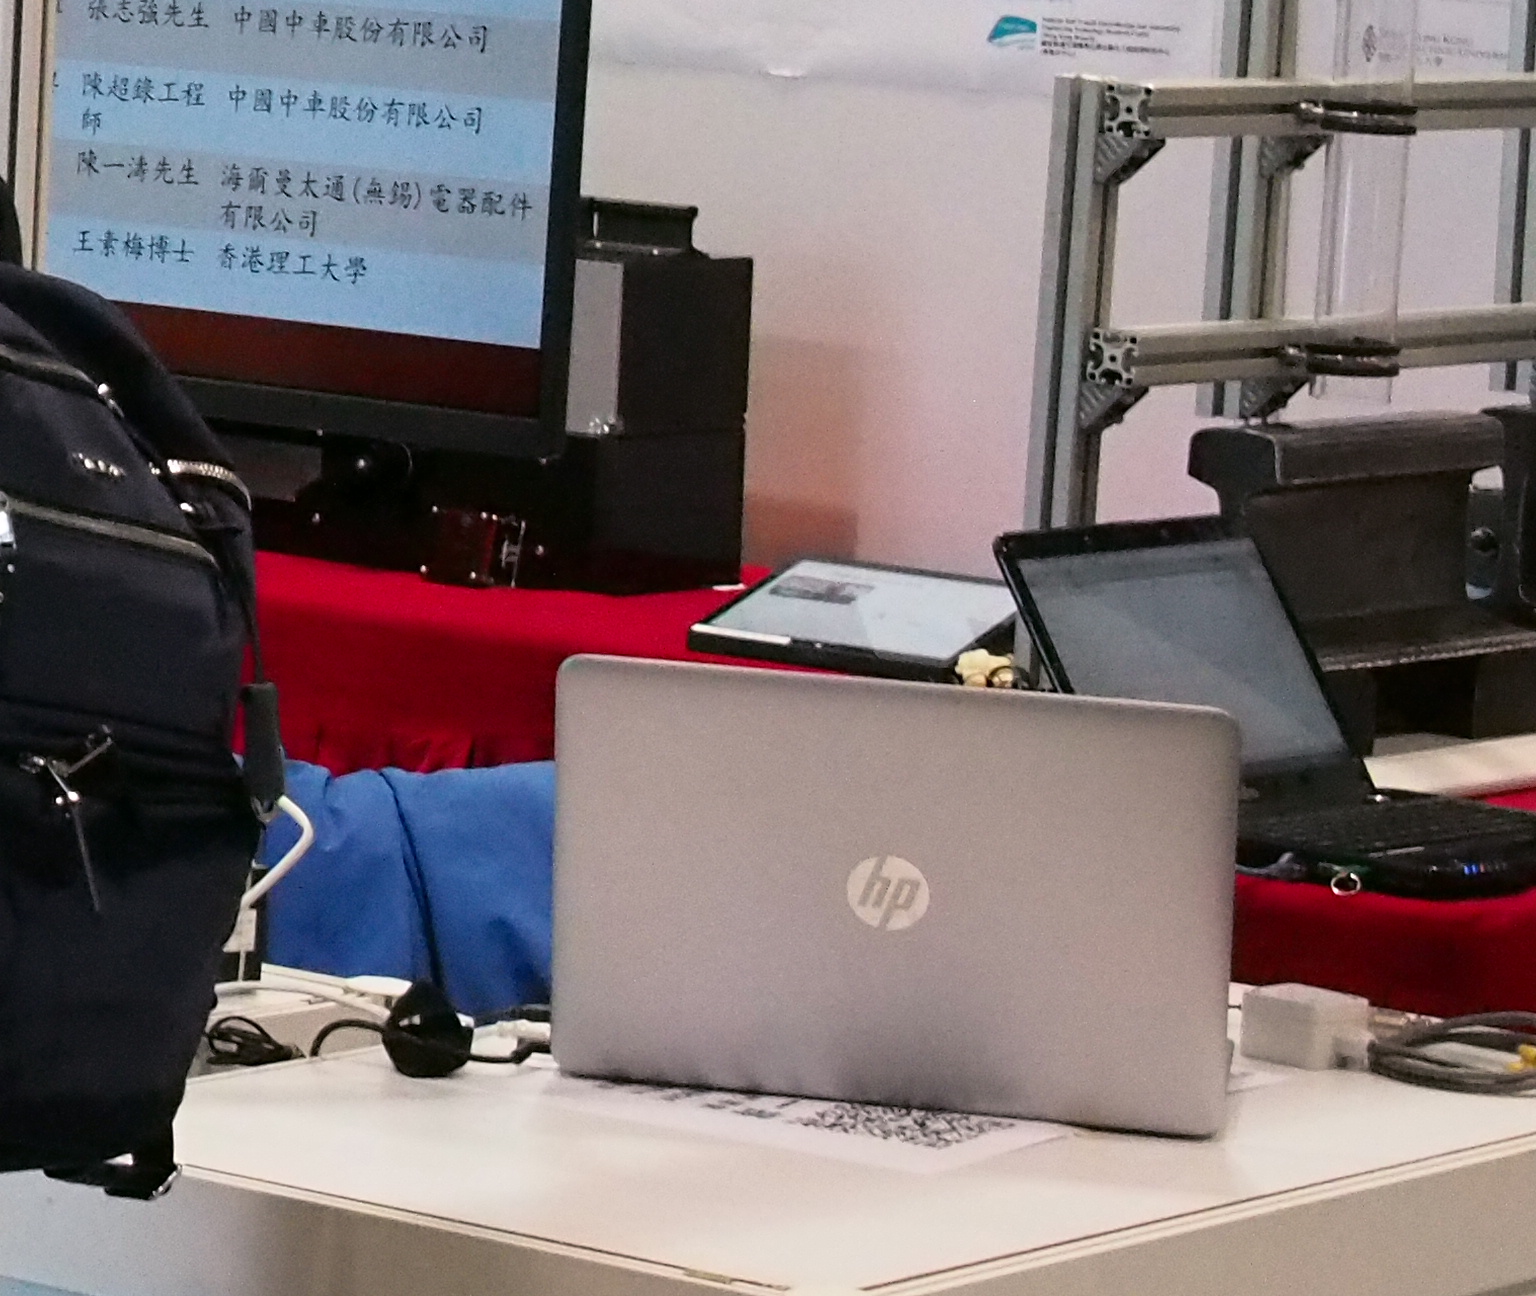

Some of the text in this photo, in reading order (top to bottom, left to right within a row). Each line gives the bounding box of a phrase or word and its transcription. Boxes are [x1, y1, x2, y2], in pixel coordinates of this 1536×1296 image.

[233, 5, 489, 54] 中國中車股份有限公司
[82, 108, 102, 136] 師
[228, 84, 483, 136] 中國中車股份有限公司
[220, 201, 318, 237] 有限公司
[219, 243, 368, 285] 香港理工大學
[857, 855, 921, 933] hp
